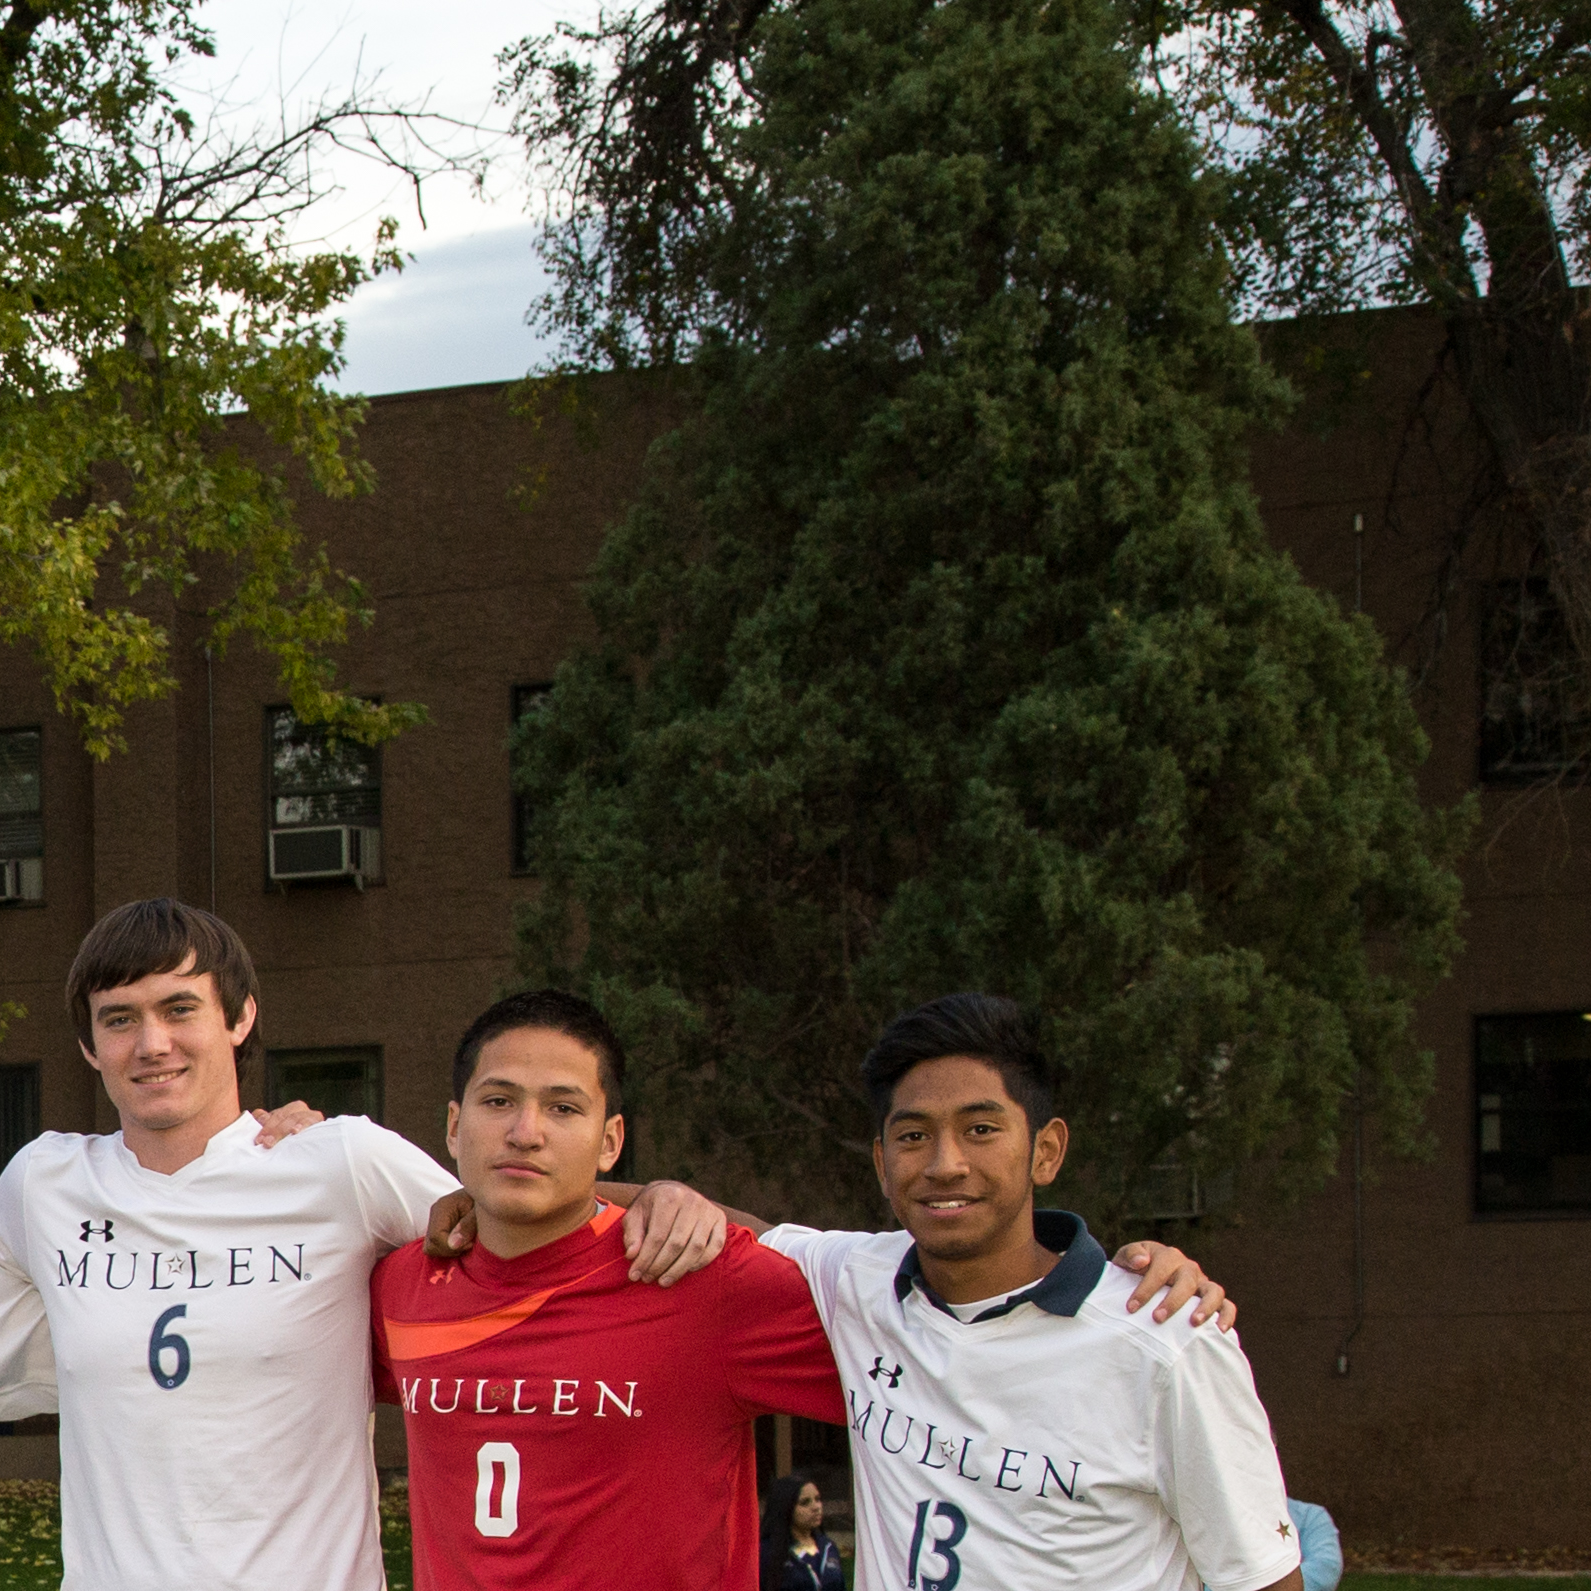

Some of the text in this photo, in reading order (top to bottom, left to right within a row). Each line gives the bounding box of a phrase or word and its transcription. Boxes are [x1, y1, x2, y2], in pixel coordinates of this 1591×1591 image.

[57, 1244, 304, 1289] MULLEN
[149, 1305, 190, 1389] 6
[403, 1378, 637, 1417] MULLEN
[845, 1390, 1082, 1501] MULLEN
[475, 1442, 520, 1537] 0
